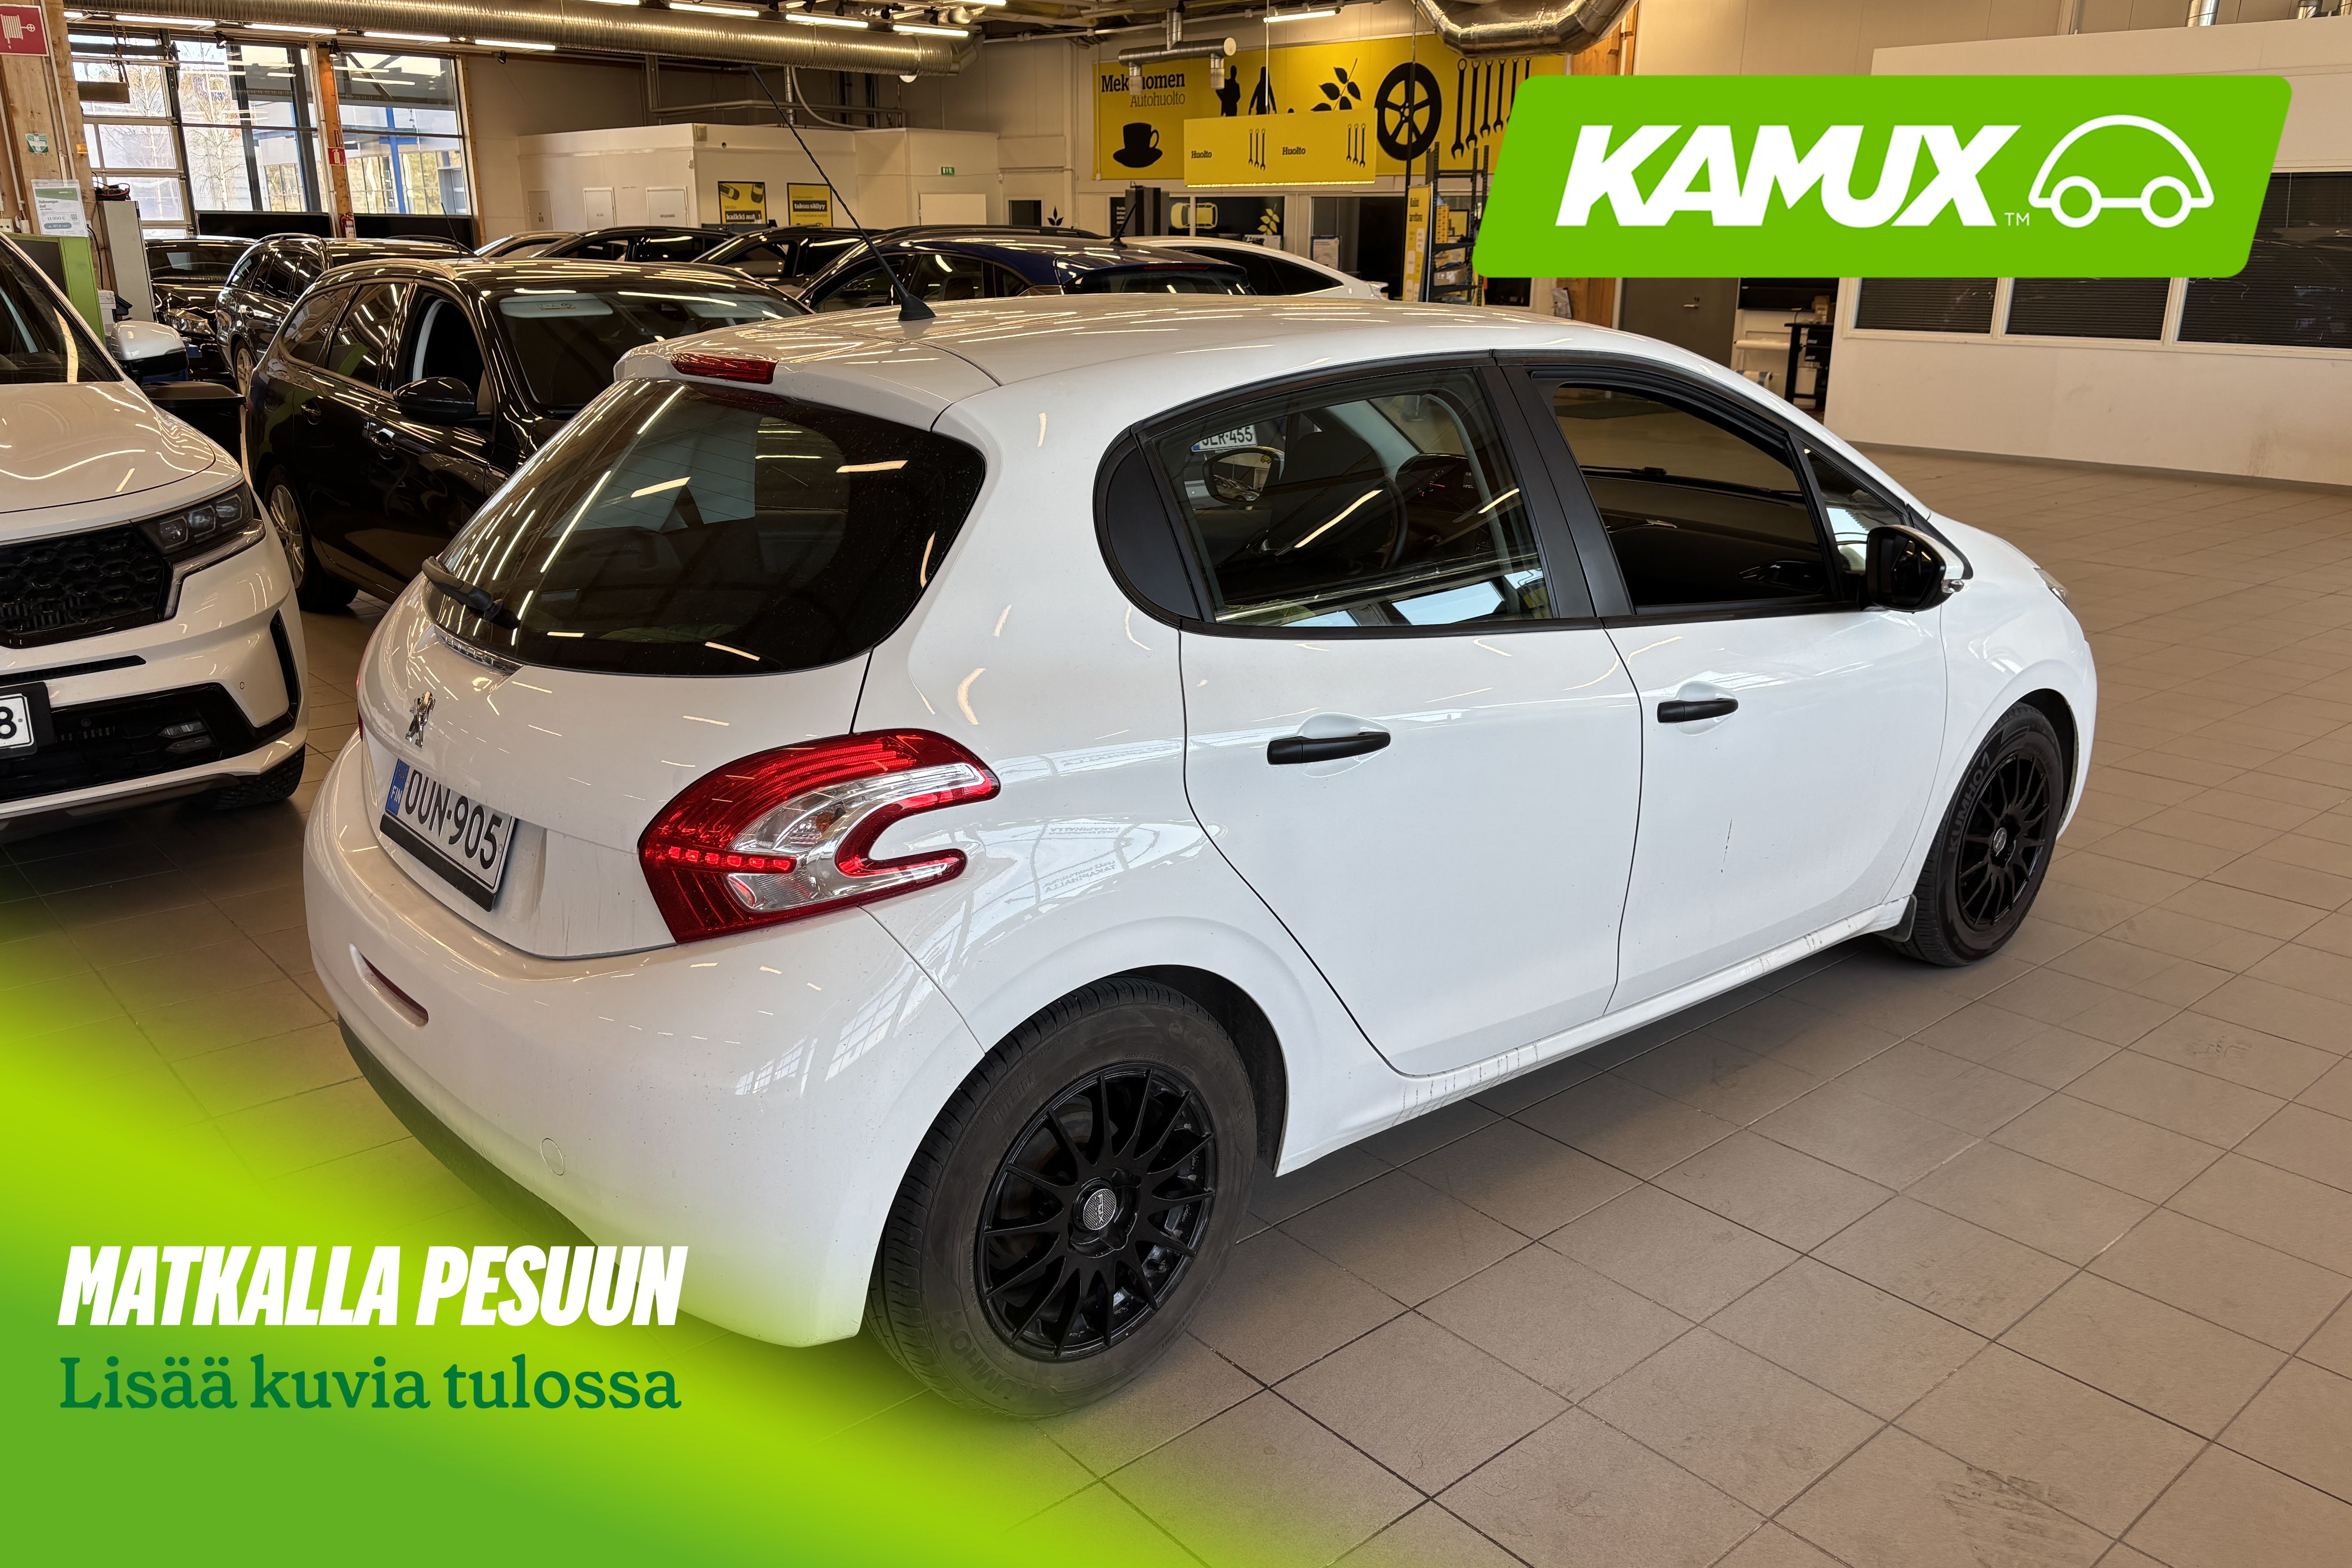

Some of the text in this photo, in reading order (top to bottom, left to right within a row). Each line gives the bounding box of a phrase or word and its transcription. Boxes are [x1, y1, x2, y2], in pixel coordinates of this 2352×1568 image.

[1101, 73, 1185, 92] Mekomen
[1130, 91, 1185, 107] Autohuolto
[1191, 150, 1212, 159] Huolto
[1282, 146, 1306, 155] Huolto
[390, 769, 503, 870] FIN OUN-905
[1948, 768, 1984, 853] KUMHO
[949, 1329, 1039, 1400] KUMHO
